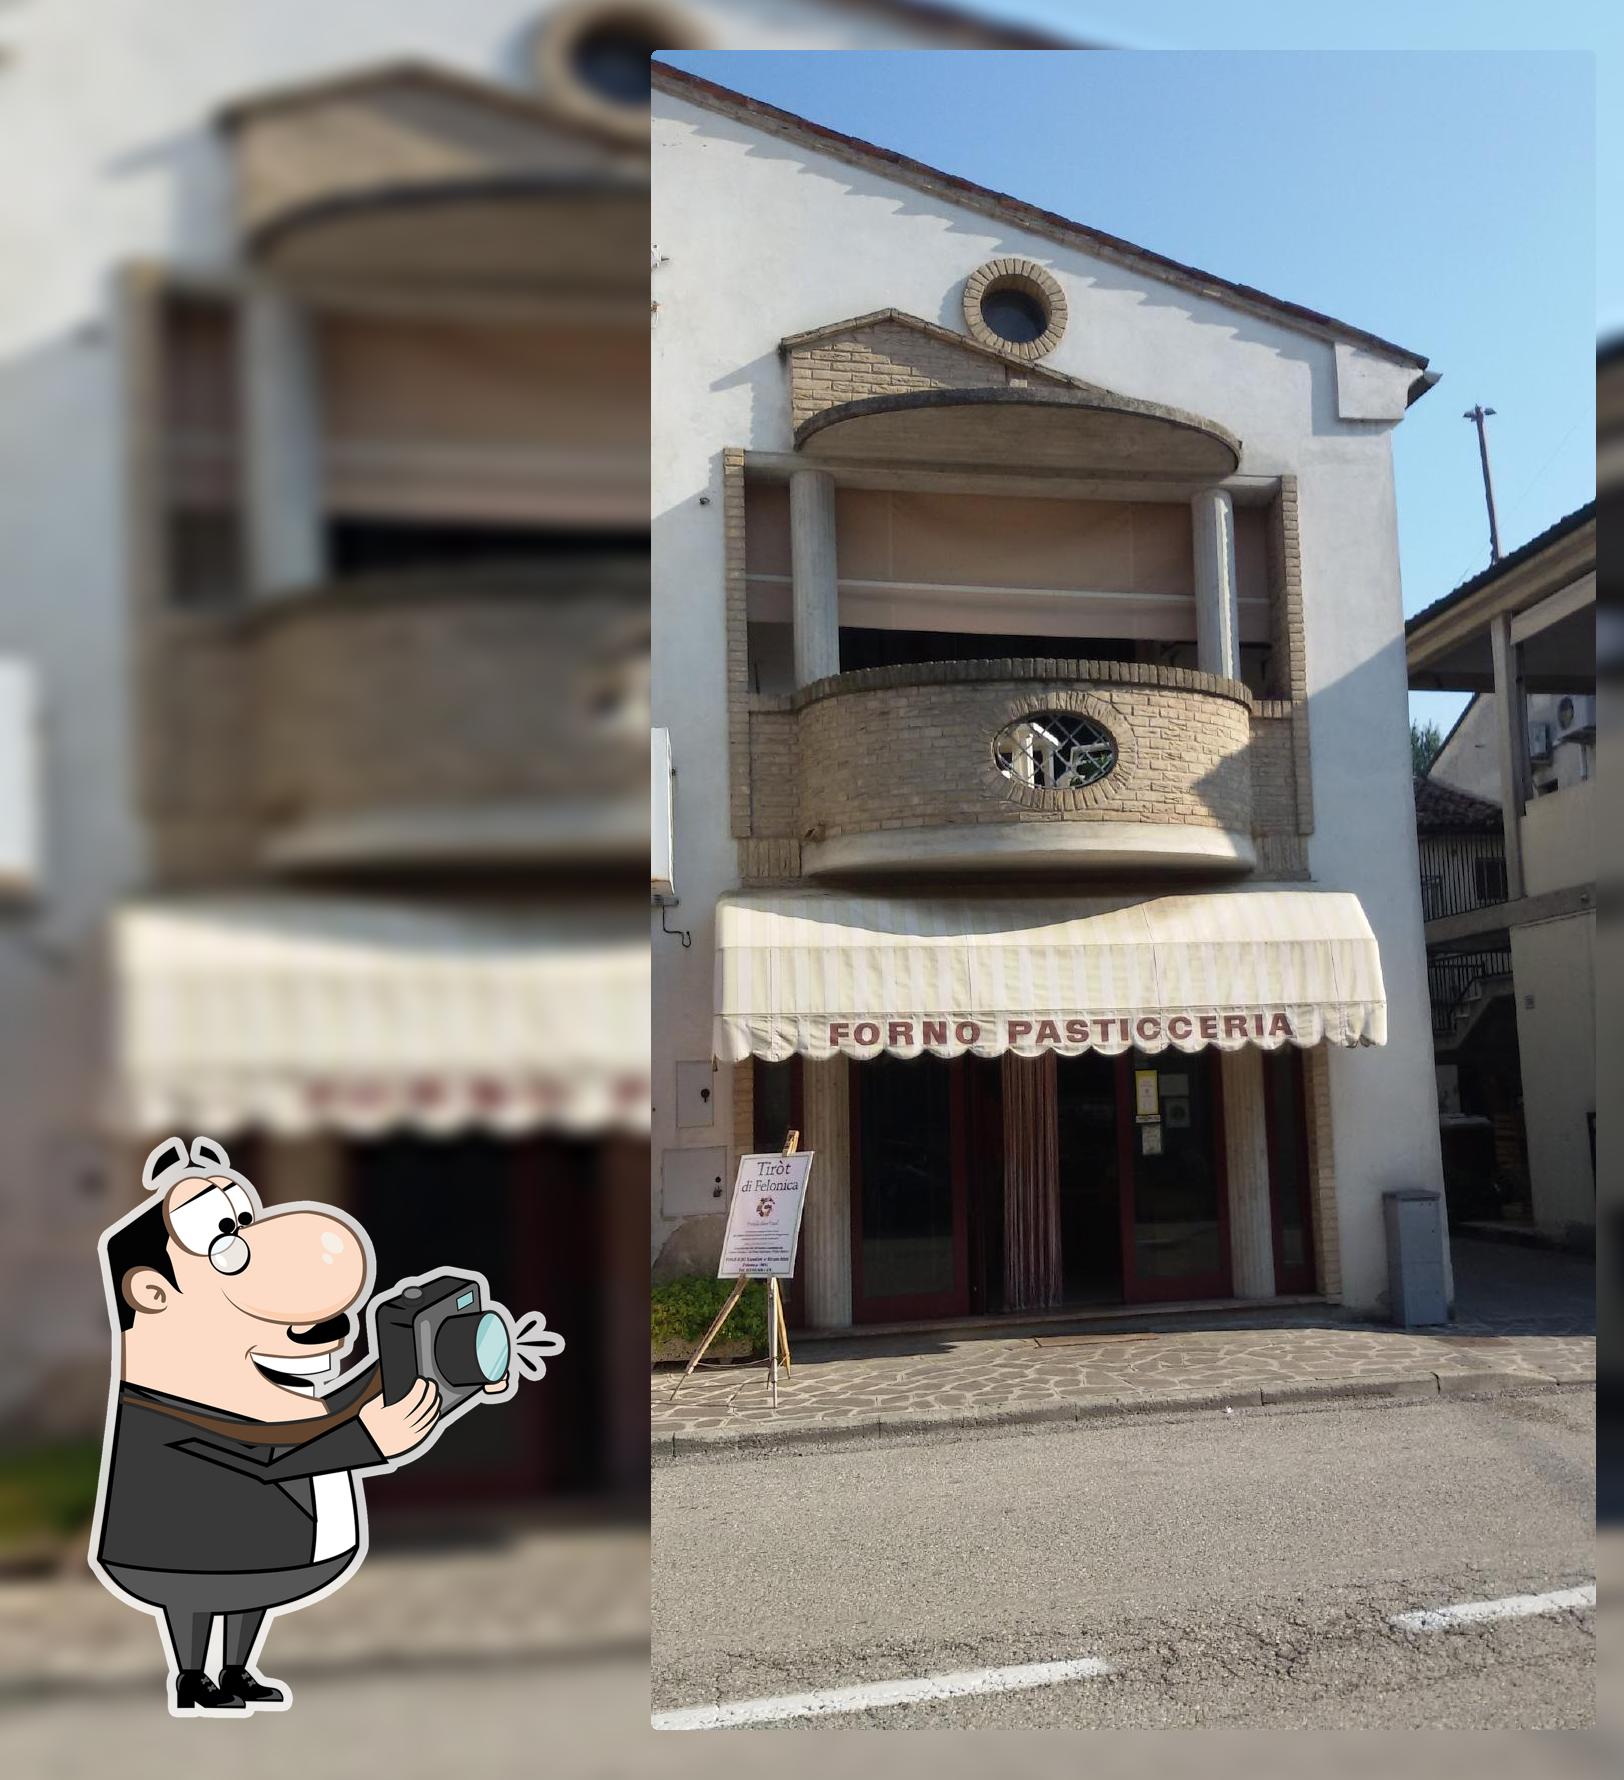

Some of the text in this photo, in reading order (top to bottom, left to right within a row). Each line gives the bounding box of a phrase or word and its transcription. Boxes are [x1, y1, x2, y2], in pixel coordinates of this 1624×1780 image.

[829, 1013, 1294, 1047] FORNO PASTICCERIA
[757, 1160, 791, 1176] Tiròt
[741, 1179, 798, 1192] di Felonica
